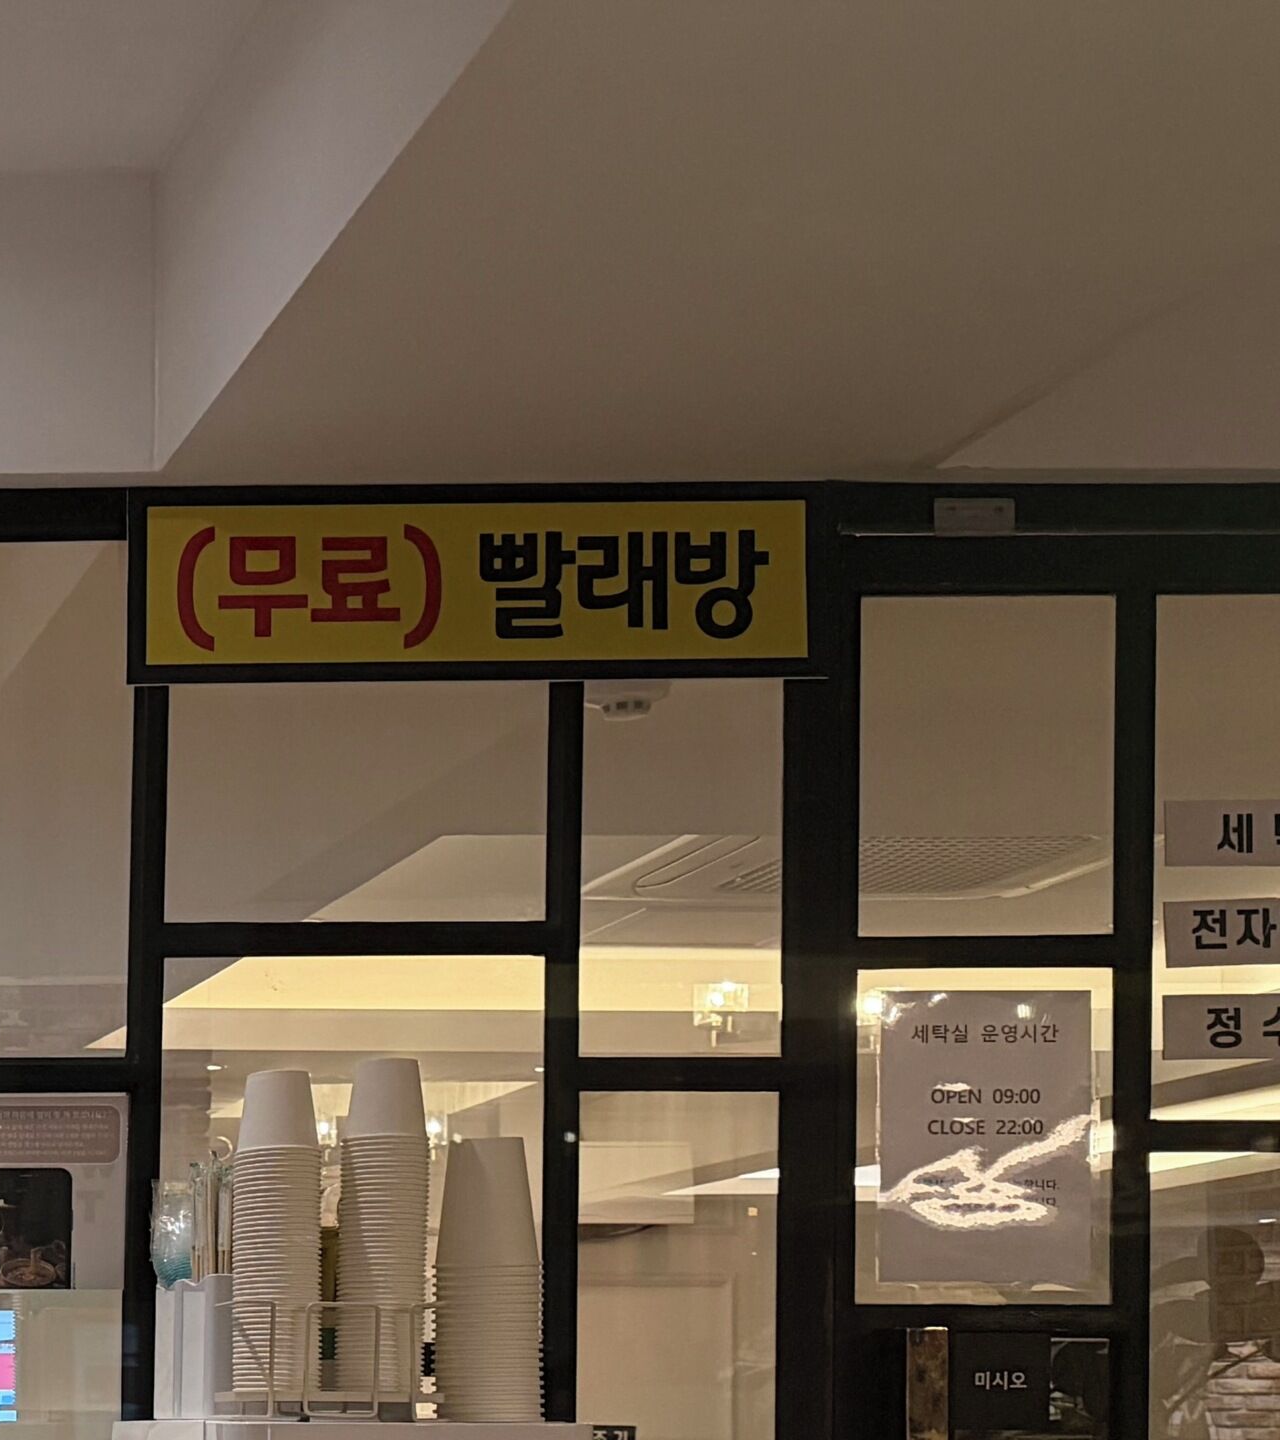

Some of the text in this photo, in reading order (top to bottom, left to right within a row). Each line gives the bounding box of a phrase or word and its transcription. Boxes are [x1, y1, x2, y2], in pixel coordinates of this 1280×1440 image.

[176, 523, 769, 651] (무료) 빨래방
[911, 1023, 1059, 1044] 세탁실 운영시간
[931, 1088, 1041, 1105] OPEN 09:00
[927, 1119, 1043, 1136] CLOSE 22:00
[974, 1371, 1028, 1390] 미시오
